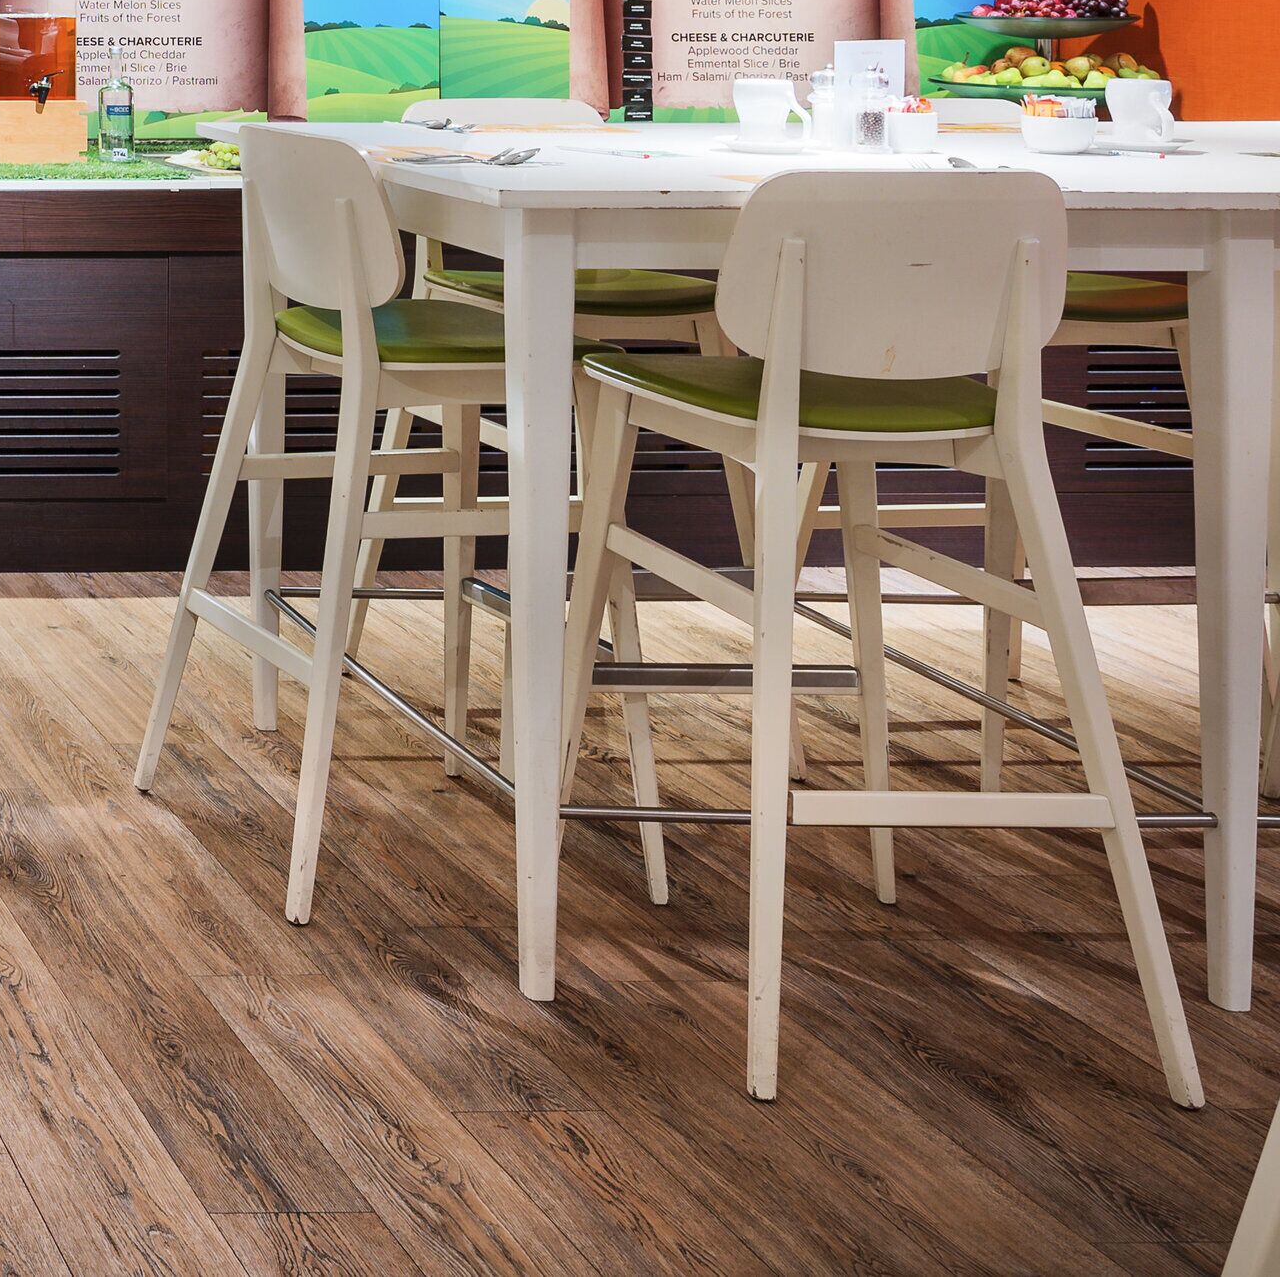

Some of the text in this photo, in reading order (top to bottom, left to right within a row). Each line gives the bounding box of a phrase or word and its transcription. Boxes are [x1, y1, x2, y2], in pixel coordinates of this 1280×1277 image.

[79, 0, 181, 10] Water Melon Slices
[80, 13, 181, 23] Fruits of the Forest
[692, 9, 792, 19] Fruits of the Forest
[76, 36, 203, 46] EESE & CHARCUTERIE
[671, 33, 815, 42] CHEESE & CHARCUTERIE
[140, 49, 186, 60] Cheddar
[688, 46, 798, 57] Applewood Cheddar
[130, 63, 187, 73] Slice / Brie
[687, 59, 800, 68] Emmental Slice / Brie
[165, 76, 170, 85] /
[172, 76, 218, 85] Pastrami
[657, 72, 682, 82] Ham
